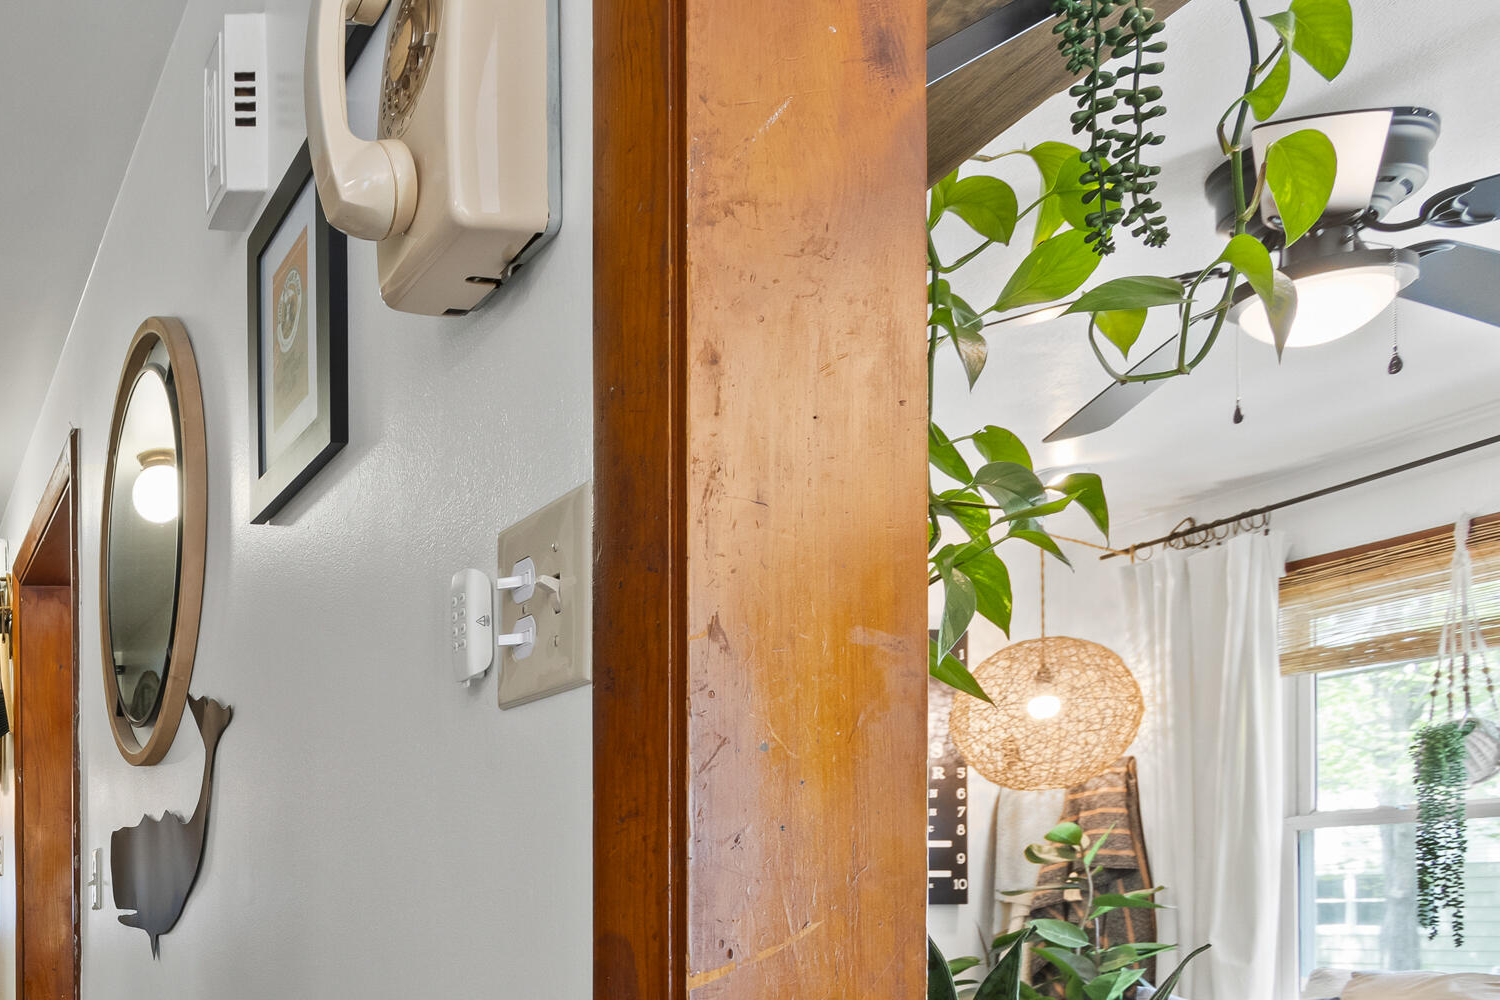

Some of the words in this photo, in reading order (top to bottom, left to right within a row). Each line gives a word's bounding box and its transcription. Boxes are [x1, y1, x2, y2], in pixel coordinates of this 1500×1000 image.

[956, 767, 966, 779] 5
[956, 788, 966, 800] 6
[956, 806, 967, 817] 7
[956, 824, 966, 836] 8
[956, 853, 966, 865] 9
[953, 878, 968, 890] 10
